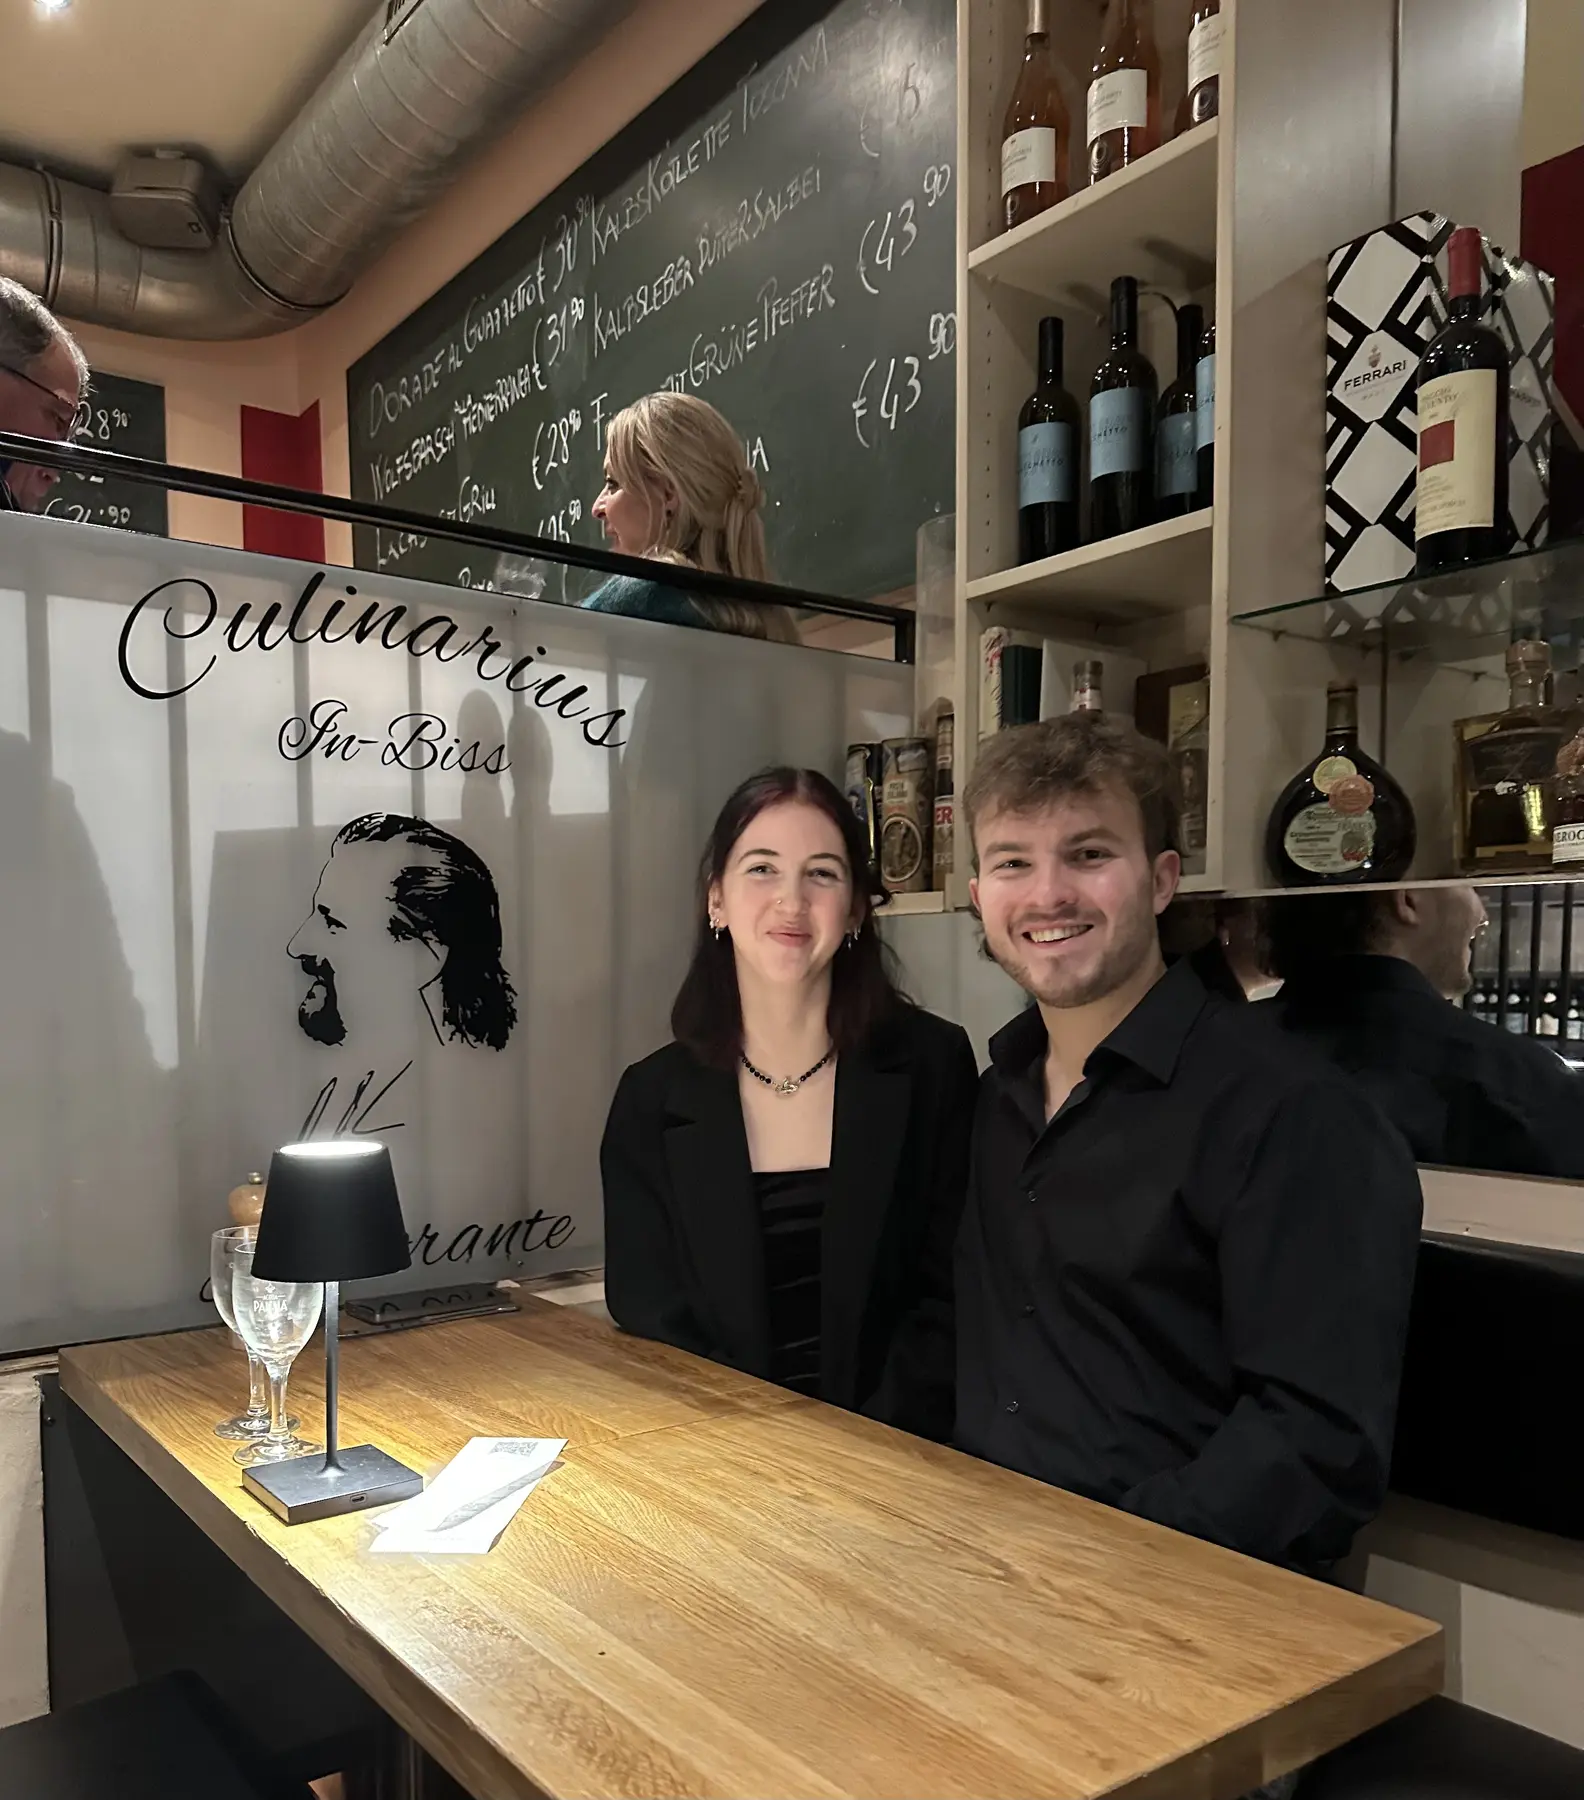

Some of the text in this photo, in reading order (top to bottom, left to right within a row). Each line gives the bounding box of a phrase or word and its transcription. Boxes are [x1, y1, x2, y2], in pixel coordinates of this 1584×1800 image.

[369, 348, 445, 439] DORADE
[1343, 360, 1406, 392] FERRARI
[118, 571, 629, 748] Culinarius
[278, 699, 513, 775] In-Biss
